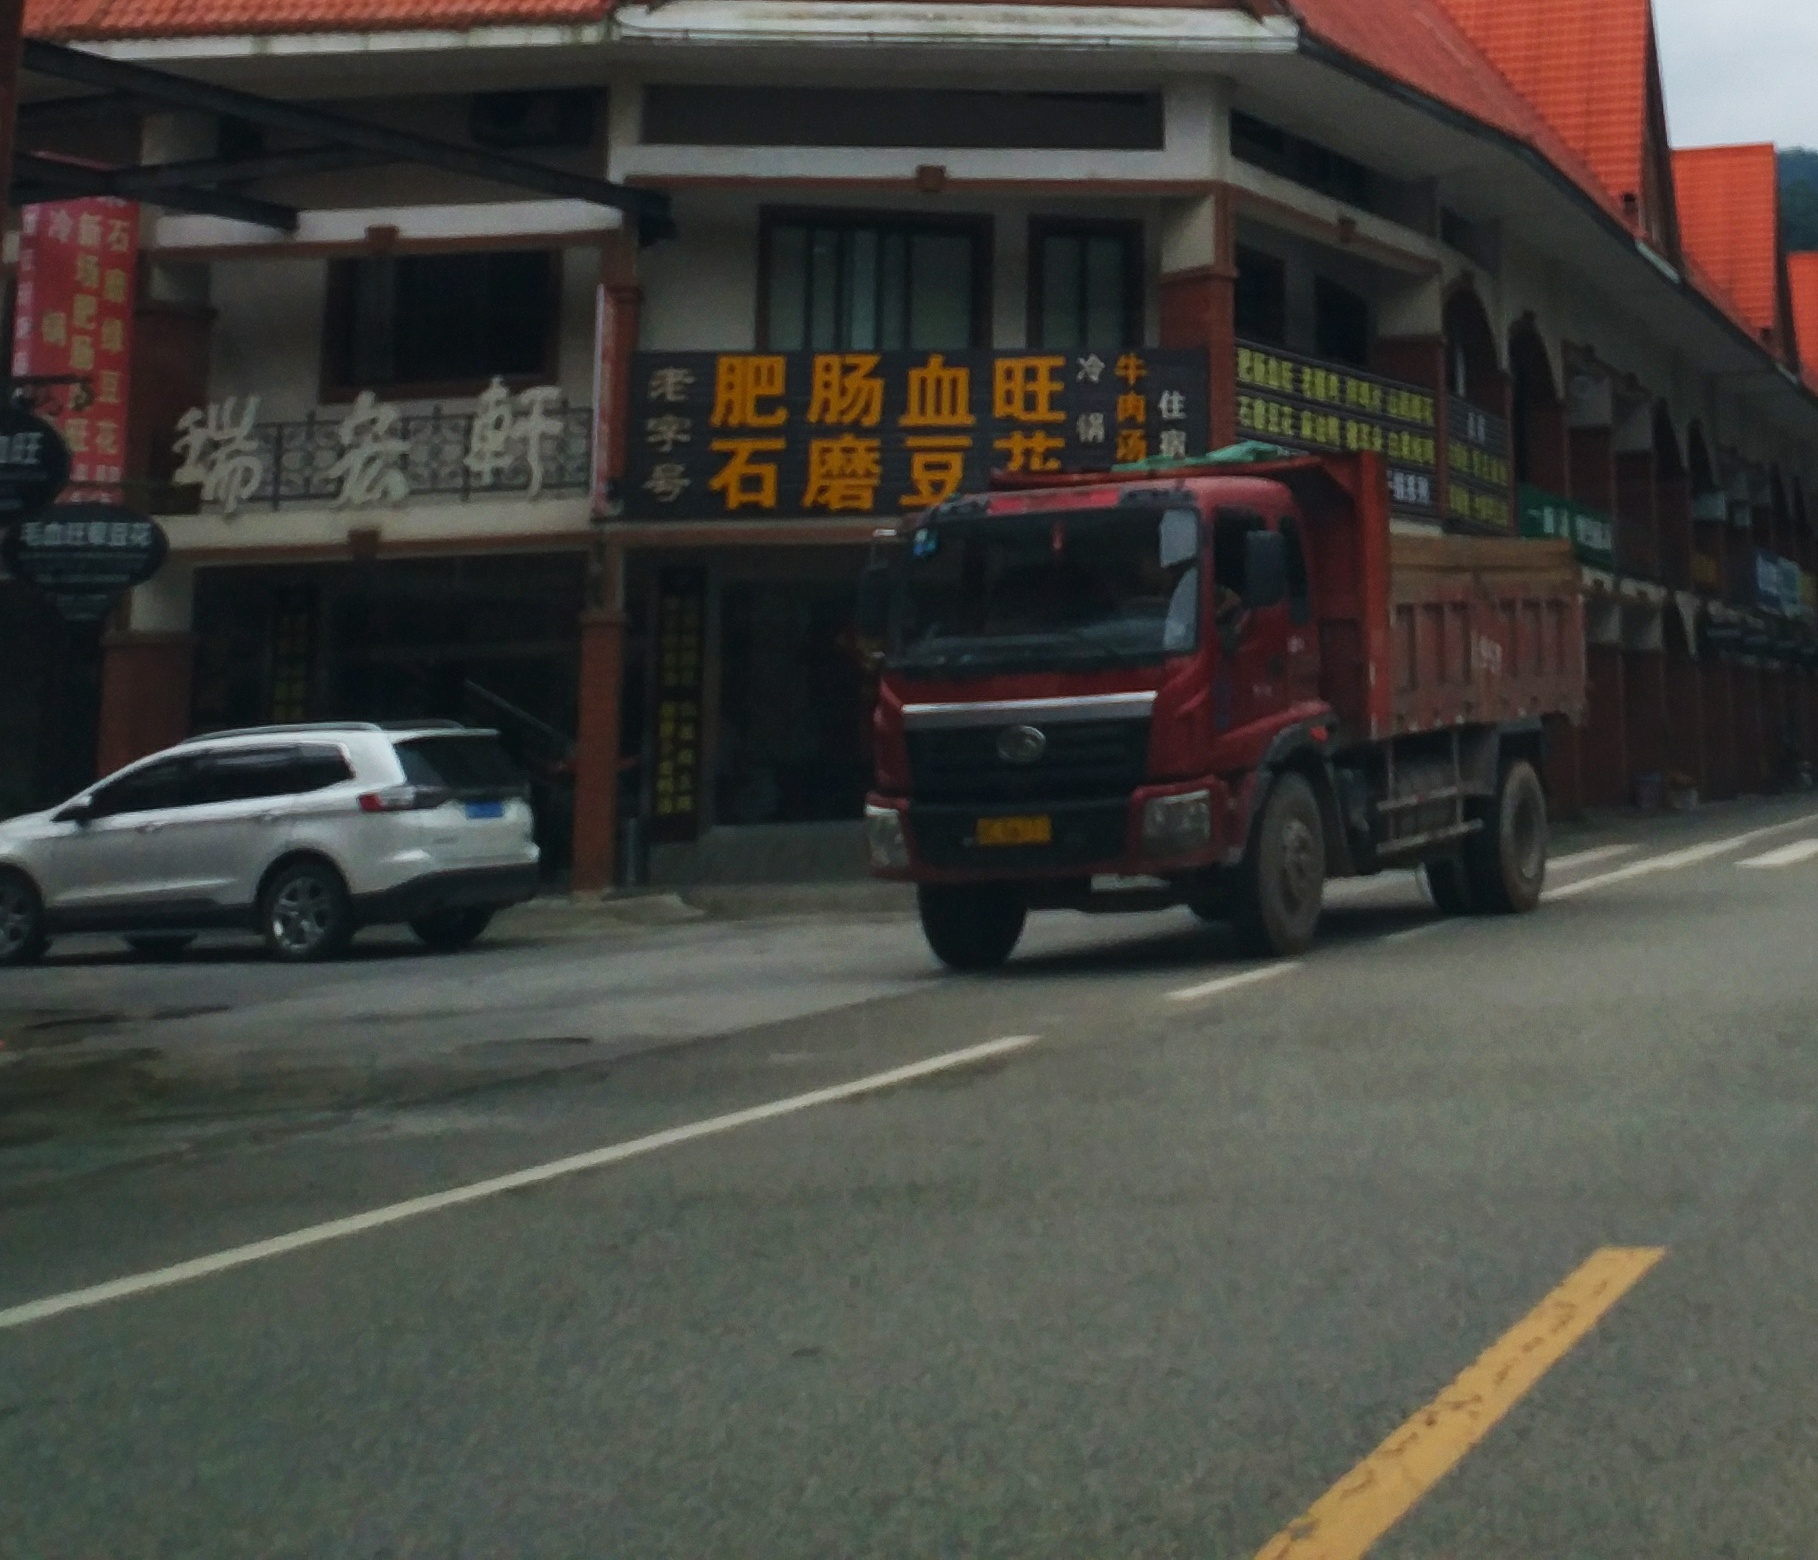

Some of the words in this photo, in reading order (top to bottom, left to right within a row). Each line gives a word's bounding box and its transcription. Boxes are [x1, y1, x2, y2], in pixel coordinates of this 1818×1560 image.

[708, 352, 1067, 428] 肥肠血旺
[642, 365, 696, 503] 老字号
[707, 435, 1066, 511] 石磨豆花
